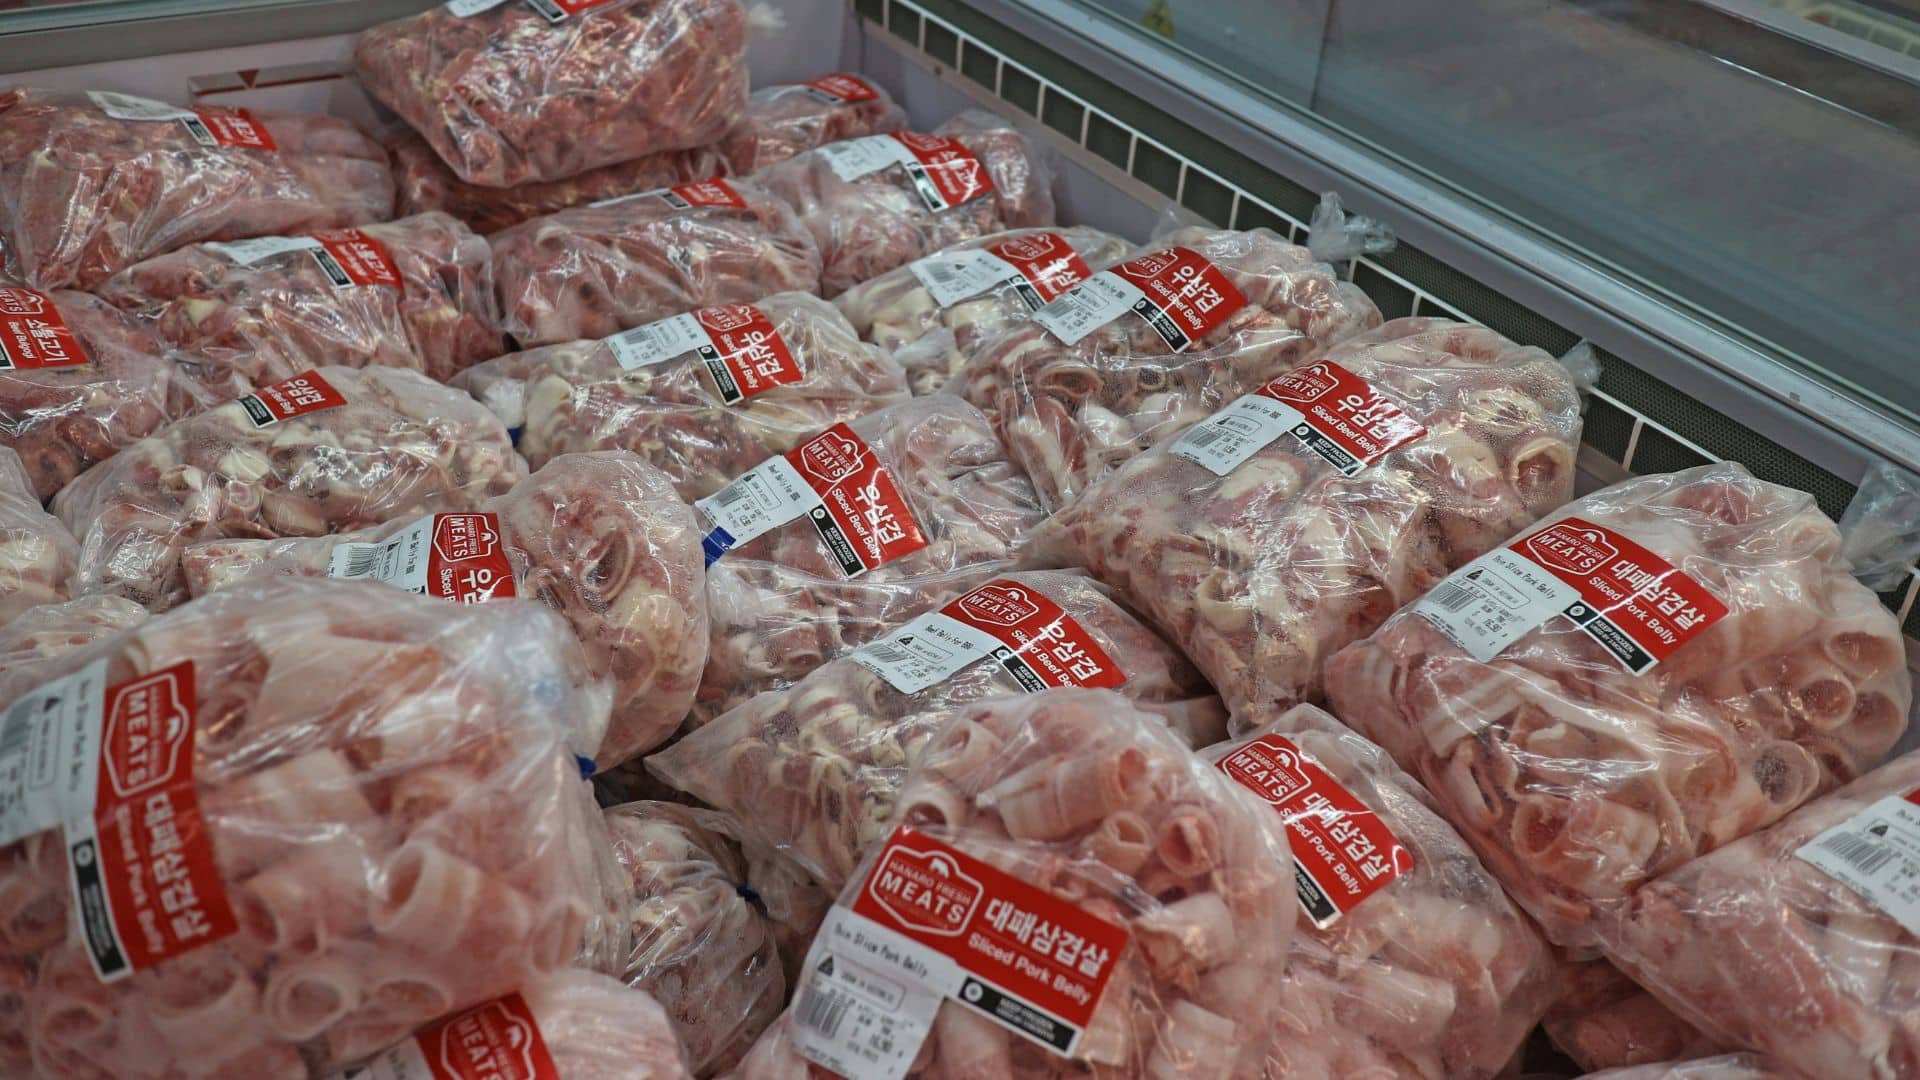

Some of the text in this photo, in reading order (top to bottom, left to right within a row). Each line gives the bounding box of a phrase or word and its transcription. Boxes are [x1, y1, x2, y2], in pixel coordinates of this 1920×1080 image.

[1150, 279, 1172, 297] Sliced
[1184, 308, 1204, 331] Belly
[1171, 266, 1225, 313] 우삼겹
[16, 335, 37, 359] Bulgogi
[25, 318, 70, 361] 소불고기
[740, 331, 784, 376] 우삼겹
[282, 379, 326, 406] 우삼겹
[743, 369, 759, 388] Belly
[1274, 377, 1320, 397] MEATS
[1311, 405, 1380, 457] Sliced Beef Belly
[809, 443, 845, 477] MEATS
[832, 488, 881, 559] Sliced Beef Belly
[855, 484, 906, 544] 우삼겹
[449, 517, 468, 557] MEATS
[1536, 534, 1596, 568] MEATS
[1580, 544, 1606, 560] FRESH
[440, 568, 455, 595] Sliced
[461, 569, 493, 606] 우삼
[1537, 583, 1556, 599] Belly
[1611, 559, 1706, 630] 대패삼겹살
[967, 595, 1019, 621] MEATS
[1589, 576, 1677, 644] Sliced Pork Belly
[1037, 652, 1062, 674] Beef
[1057, 673, 1078, 688] Bel
[1038, 621, 1103, 680] 우삼겹
[127, 690, 148, 786] MEATS
[1231, 754, 1288, 797] MEATS
[1280, 808, 1361, 895] Sced Pork Belly
[1302, 792, 1391, 880] 대패삼겹살
[145, 792, 212, 940] 대패삼겹살
[880, 870, 965, 924] MEATS
[983, 897, 1109, 979] 대패삼겹살
[967, 931, 1092, 1006] Sliced Pork Belly
